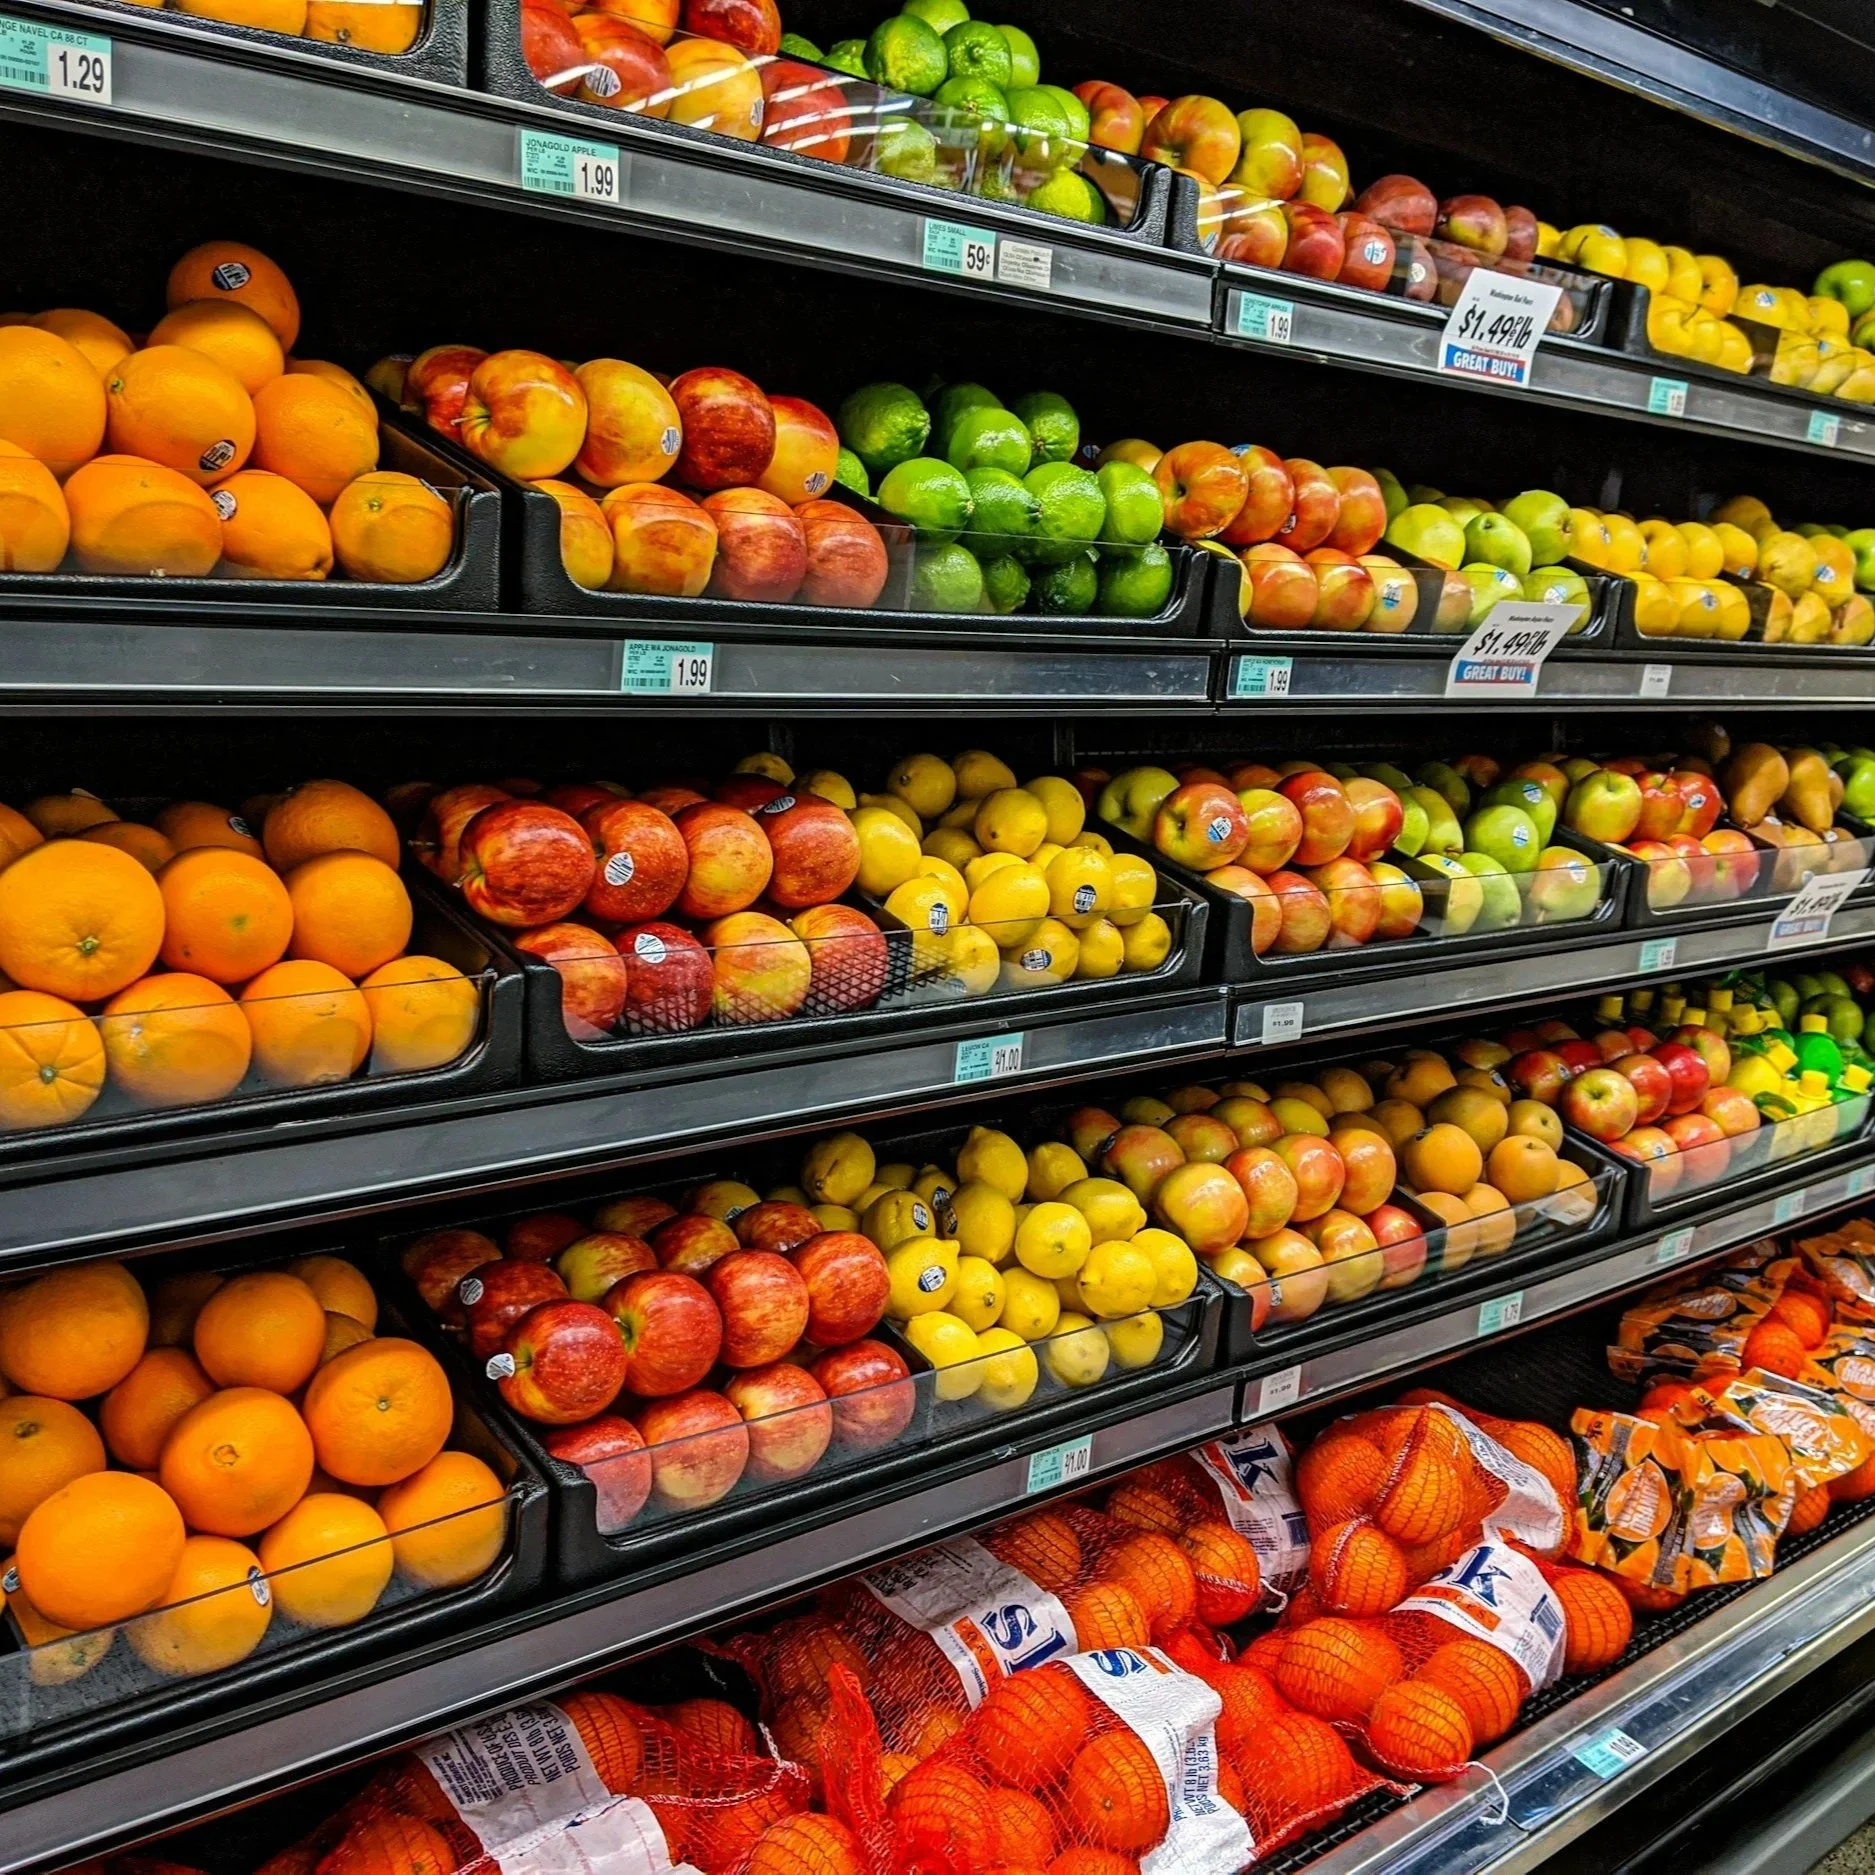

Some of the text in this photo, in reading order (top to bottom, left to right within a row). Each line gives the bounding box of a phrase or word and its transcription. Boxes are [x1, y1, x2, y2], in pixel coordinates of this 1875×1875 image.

[19, 24, 48, 38] NAVEL
[50, 30, 63, 41] CA
[76, 36, 89, 46] CT
[59, 50, 104, 93] 1.29
[526, 138, 597, 157] JONAGOLD APPLE
[582, 162, 614, 196] 1.99
[947, 225, 967, 236] SMALL
[1271, 315, 1289, 340] 1.99
[1459, 304, 1514, 345] $1.49
[1453, 350, 1490, 373] GREAT
[1491, 357, 1519, 378] BUY!
[651, 644, 661, 652] WA
[662, 645, 696, 653] JONAGOLD
[1473, 628, 1531, 656] $1.49
[678, 658, 707, 686] 1.99
[1271, 670, 1288, 691] 1.99
[1463, 665, 1527, 681] GREAT BUY!
[502, 1731, 522, 1749] DES
[546, 1725, 568, 1746] NET
[484, 1742, 504, 1754] OF
[532, 1745, 553, 1765] WT
[555, 1743, 581, 1774] POIDS
[492, 1752, 525, 1791] PRODUCE
[511, 1750, 541, 1785] PRODUIT
[541, 1762, 562, 1783] NET
[1185, 1768, 1198, 1777] lb
[1196, 1736, 1220, 1815] POIDS NET 3.63 kg
[1184, 1788, 1196, 1805] WT
[1187, 1804, 1208, 1817] NET
